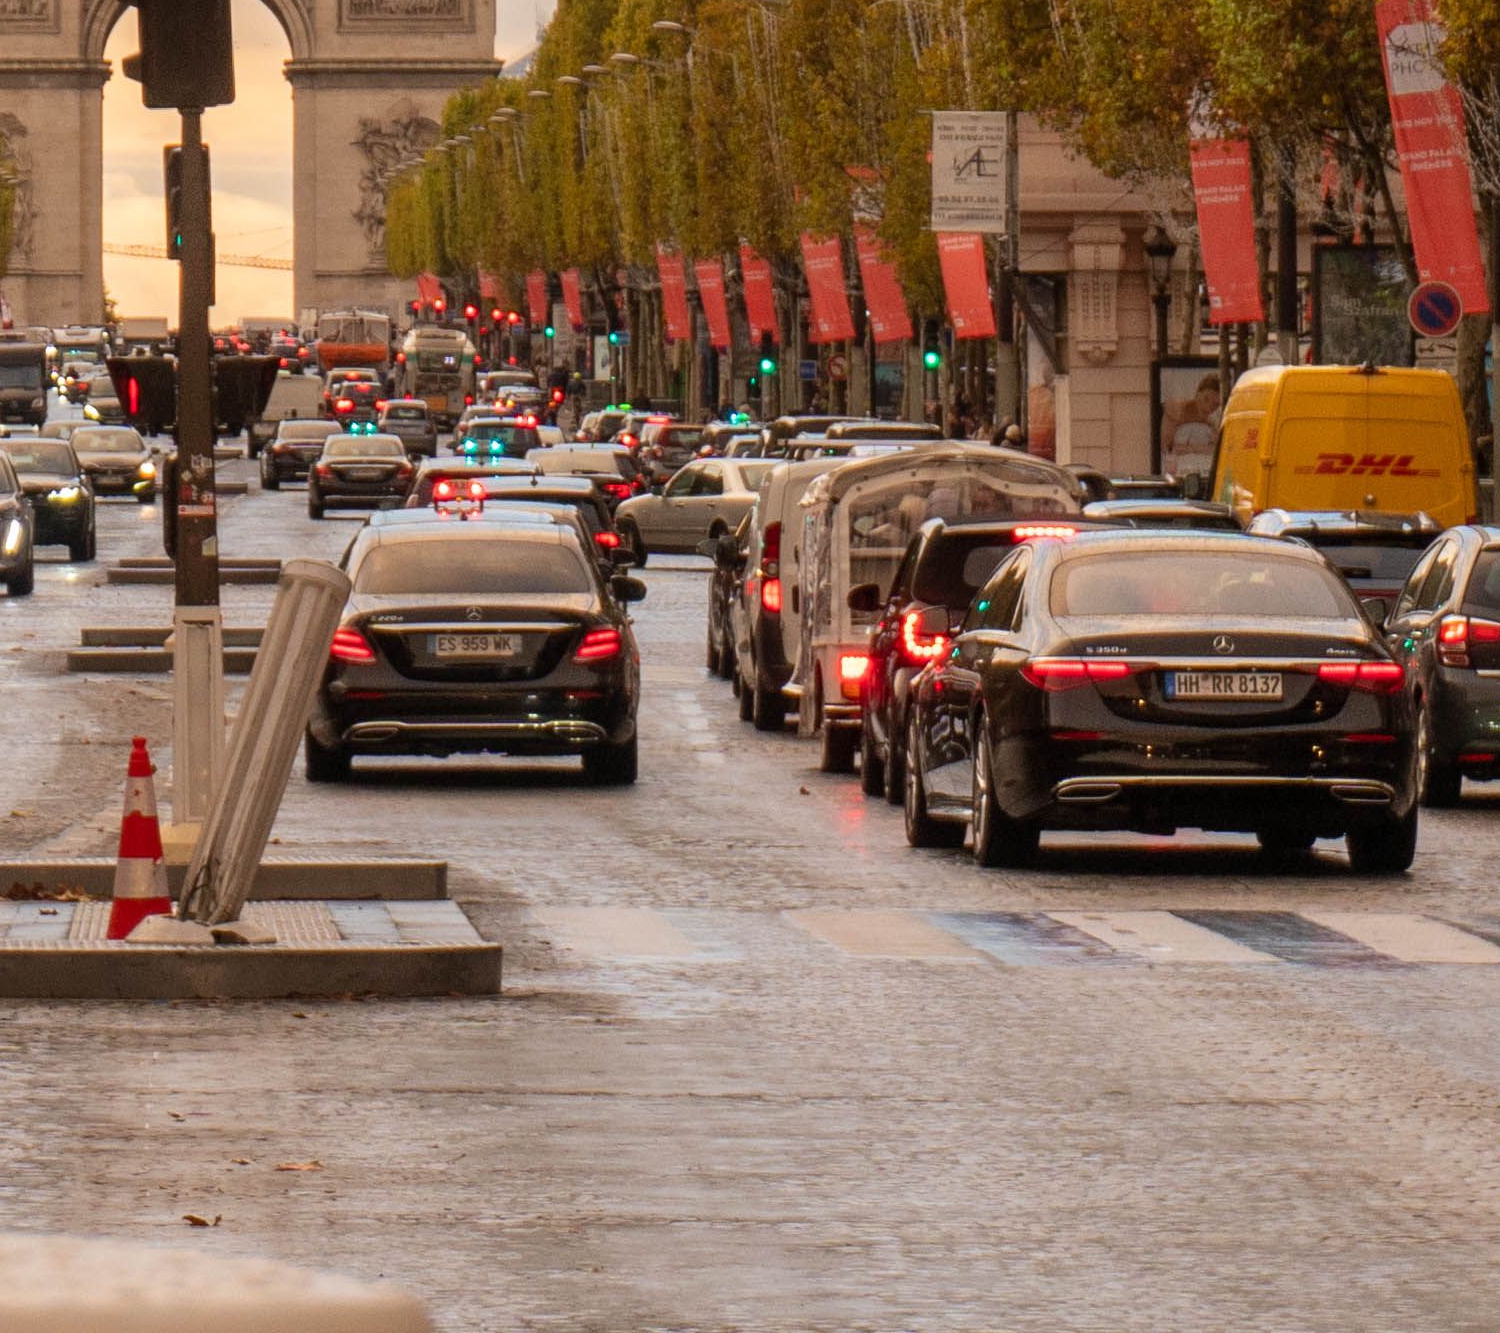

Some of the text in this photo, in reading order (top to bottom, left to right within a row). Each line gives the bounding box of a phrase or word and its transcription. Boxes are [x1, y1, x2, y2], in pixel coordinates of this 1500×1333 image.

[1313, 452, 1420, 477] DHL
[1176, 674, 1281, 693] HH RR 8137
